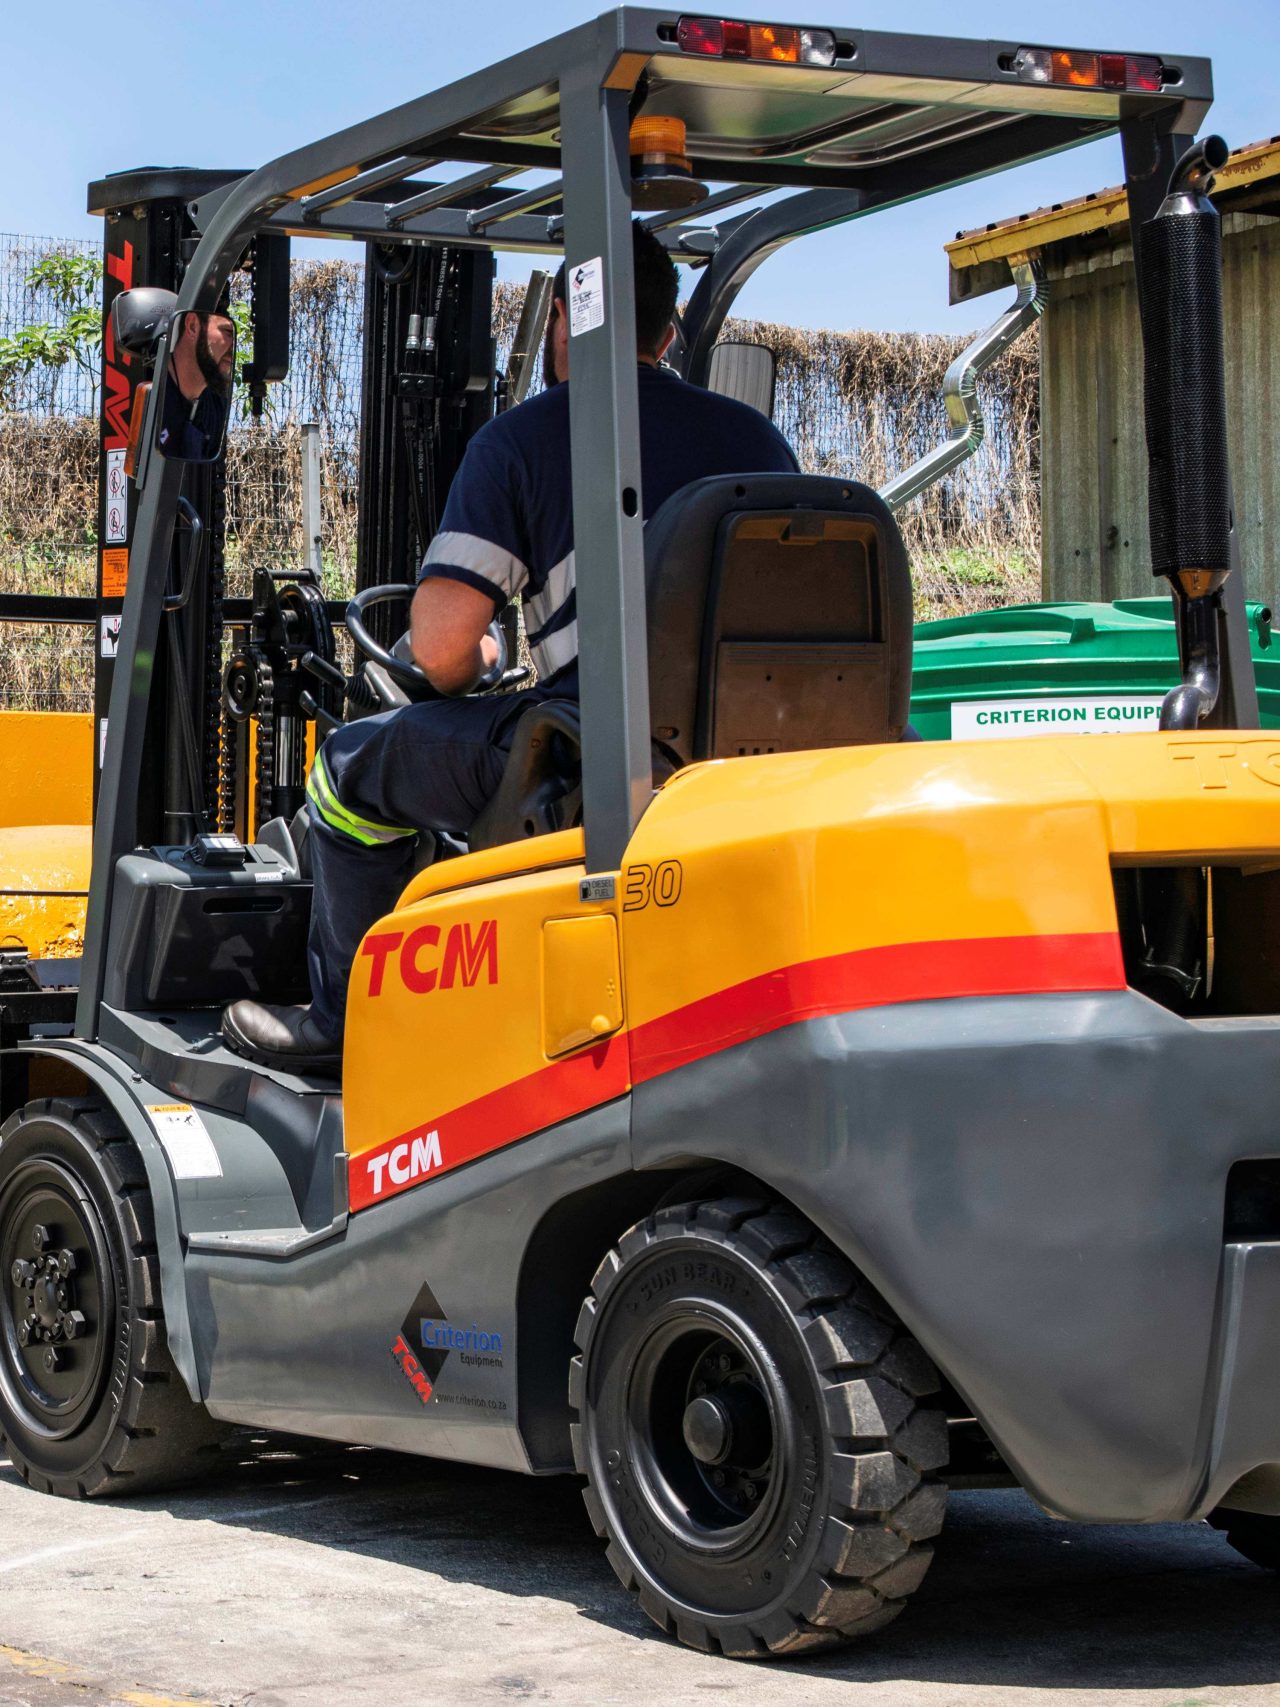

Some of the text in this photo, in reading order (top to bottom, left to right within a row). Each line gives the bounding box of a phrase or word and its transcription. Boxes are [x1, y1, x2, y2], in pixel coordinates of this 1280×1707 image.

[976, 707, 1087, 725] CRITERION
[591, 878, 613, 889] DIESEL
[594, 888, 610, 898] FUEL
[623, 859, 683, 912] 30
[361, 919, 499, 997] TCM
[366, 1129, 443, 1194] TCM
[422, 1320, 503, 1354] Criterion
[391, 1335, 433, 1404] TCM
[460, 1352, 503, 1369] Equipment
